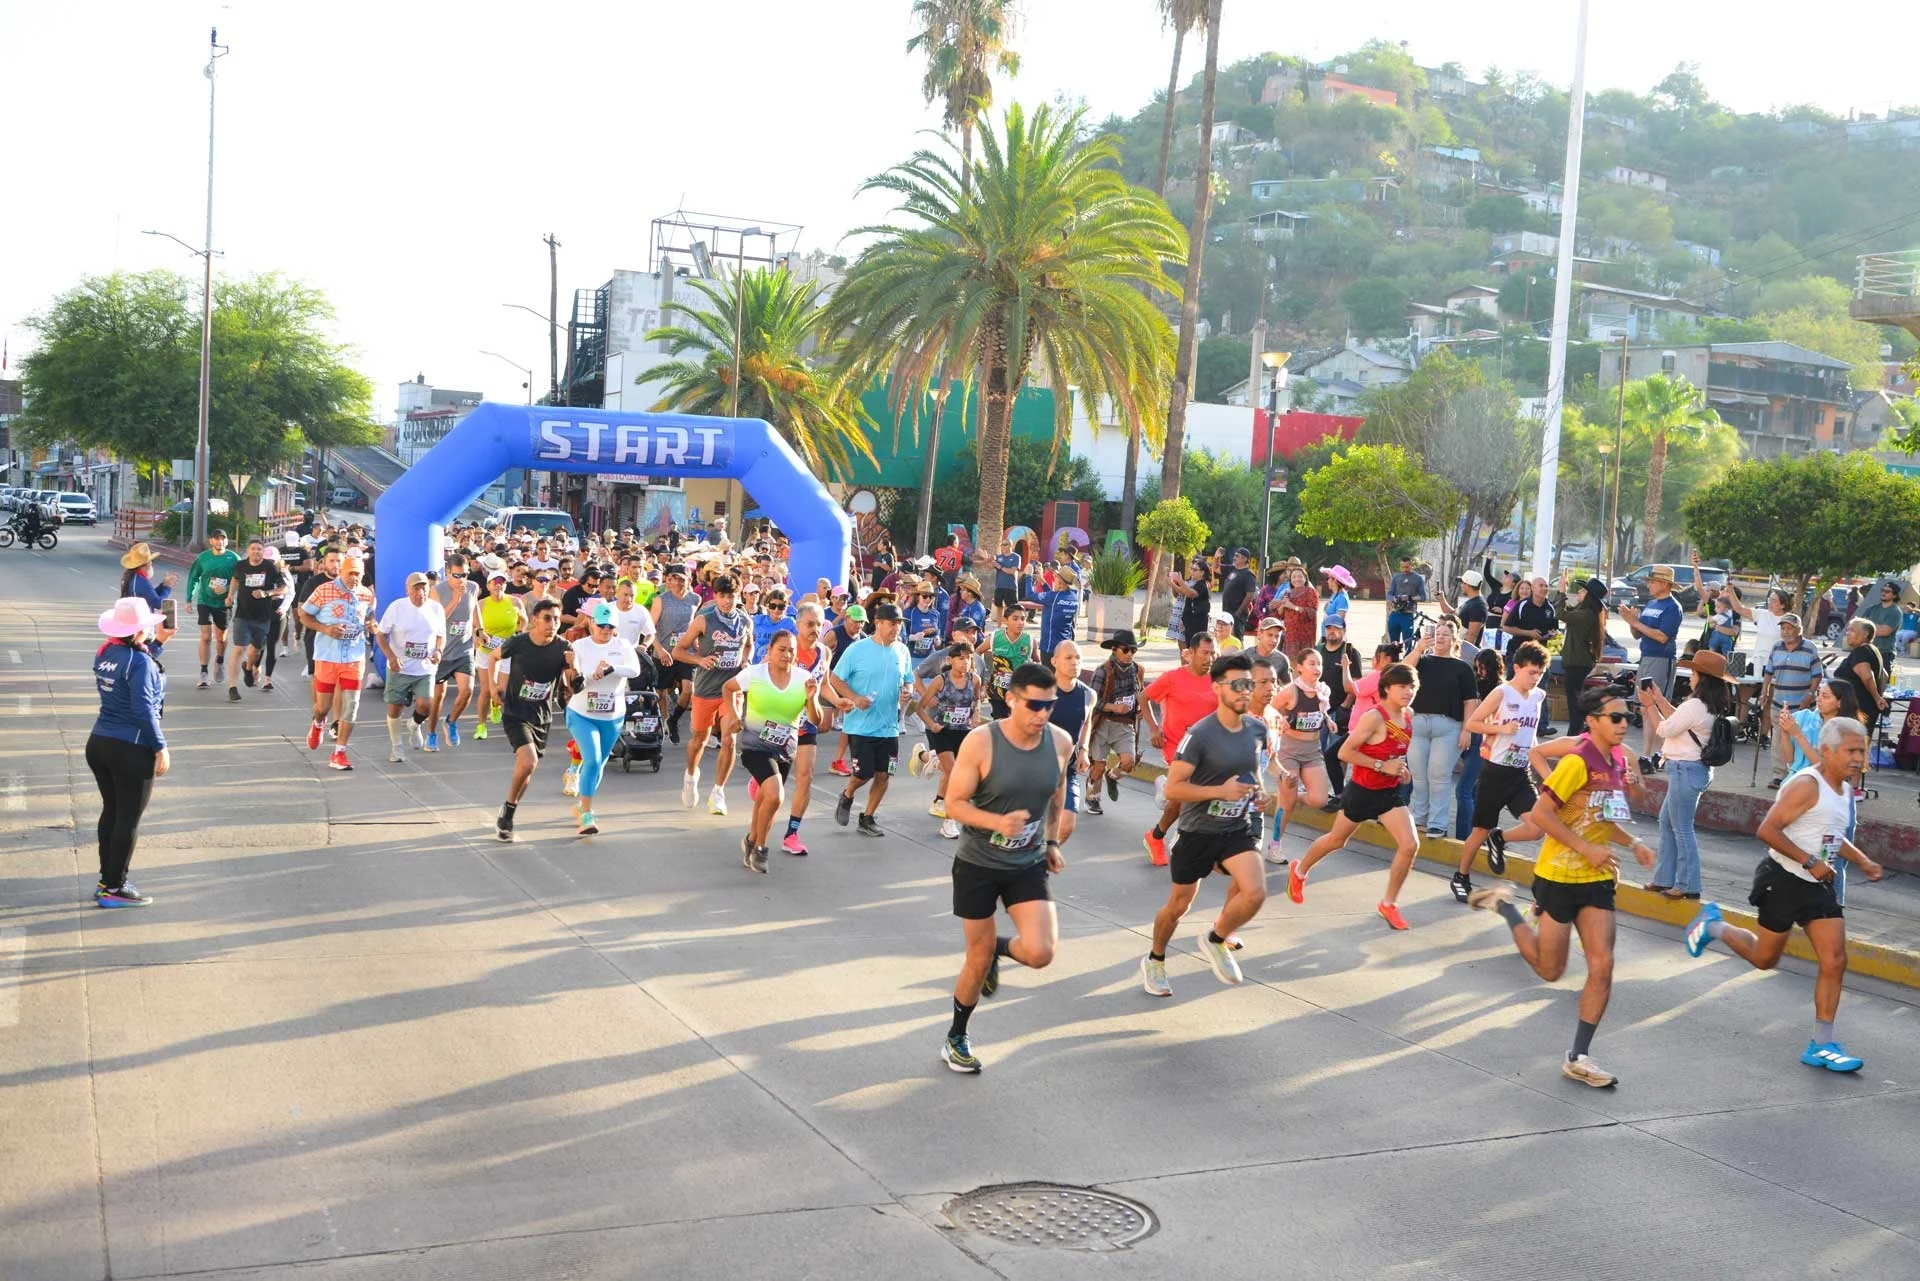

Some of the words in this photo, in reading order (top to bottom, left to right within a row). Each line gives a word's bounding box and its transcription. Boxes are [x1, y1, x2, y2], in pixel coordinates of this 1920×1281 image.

[539, 420, 723, 465] START
[940, 555, 956, 569] 74
[595, 702, 609, 710] 120
[768, 734, 785, 744] 266
[1005, 837, 1026, 848] 170
